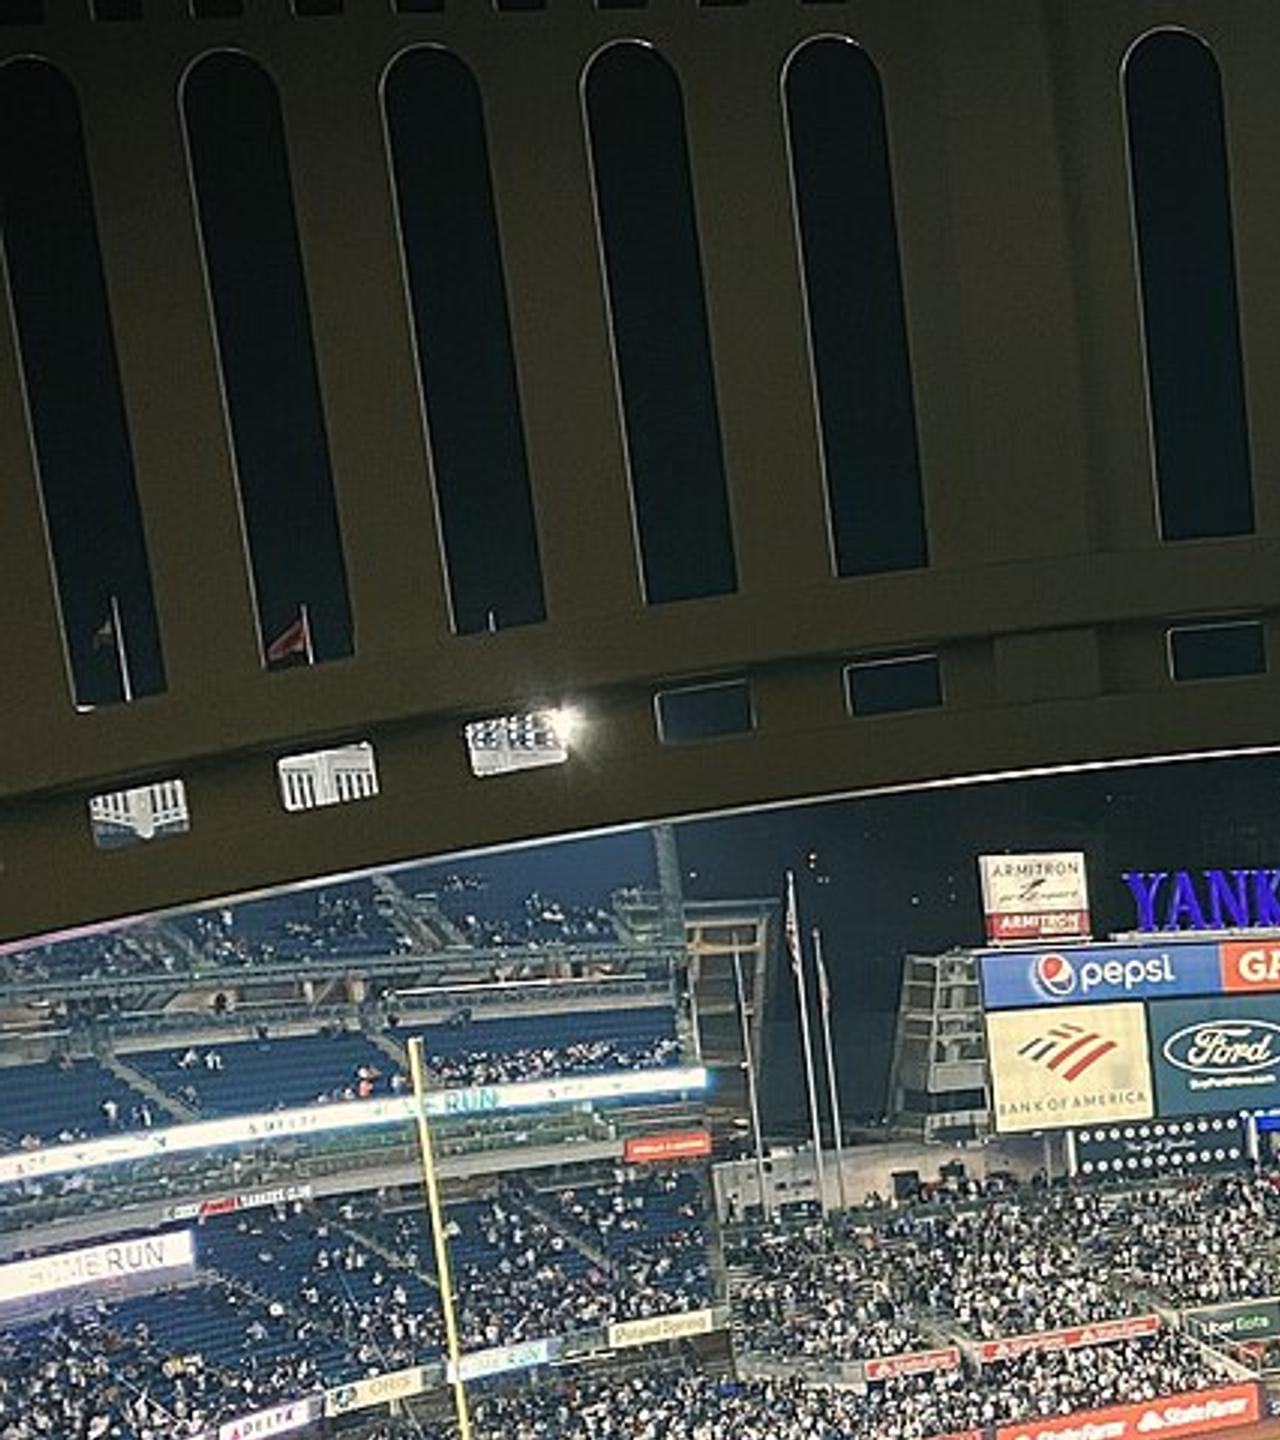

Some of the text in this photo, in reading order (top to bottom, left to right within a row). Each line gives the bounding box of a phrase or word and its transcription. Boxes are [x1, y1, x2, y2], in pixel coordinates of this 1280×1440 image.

[991, 861, 1079, 877] ARMITRON
[1000, 913, 1080, 930] ARMITRON
[1080, 954, 1176, 993] pepsi
[1187, 1027, 1273, 1065] Ford
[999, 1090, 1147, 1117] BANK OF AMERICA
[106, 1241, 165, 1270] RUN
[1199, 1321, 1235, 1337] Uber
